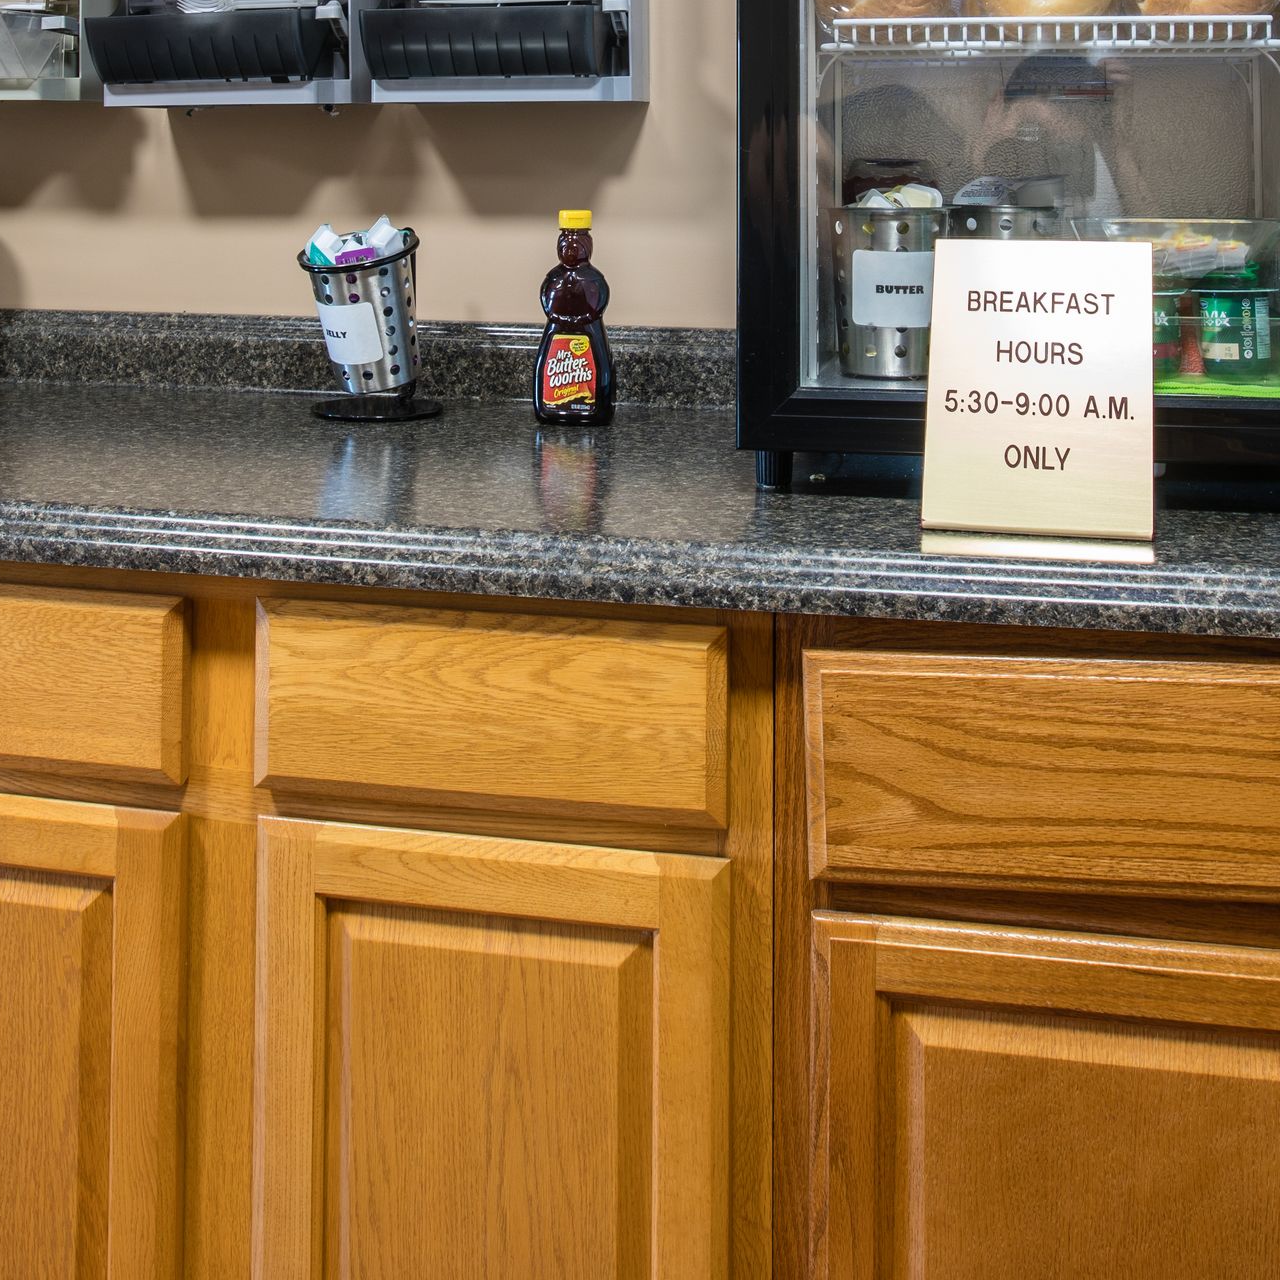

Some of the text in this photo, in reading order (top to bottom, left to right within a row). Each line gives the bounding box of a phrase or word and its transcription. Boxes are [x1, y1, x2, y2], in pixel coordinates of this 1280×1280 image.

[875, 284, 924, 295] BUTTER
[967, 290, 1116, 316] BREAKFAST
[556, 349, 573, 360] Mrs.
[996, 340, 1084, 366] HOURS
[547, 357, 589, 376] Butter-
[549, 367, 593, 388] worth's
[553, 384, 579, 399] Original
[944, 389, 1135, 421] 5:30-9:00 A.M.
[1004, 444, 1071, 471] ONLY
